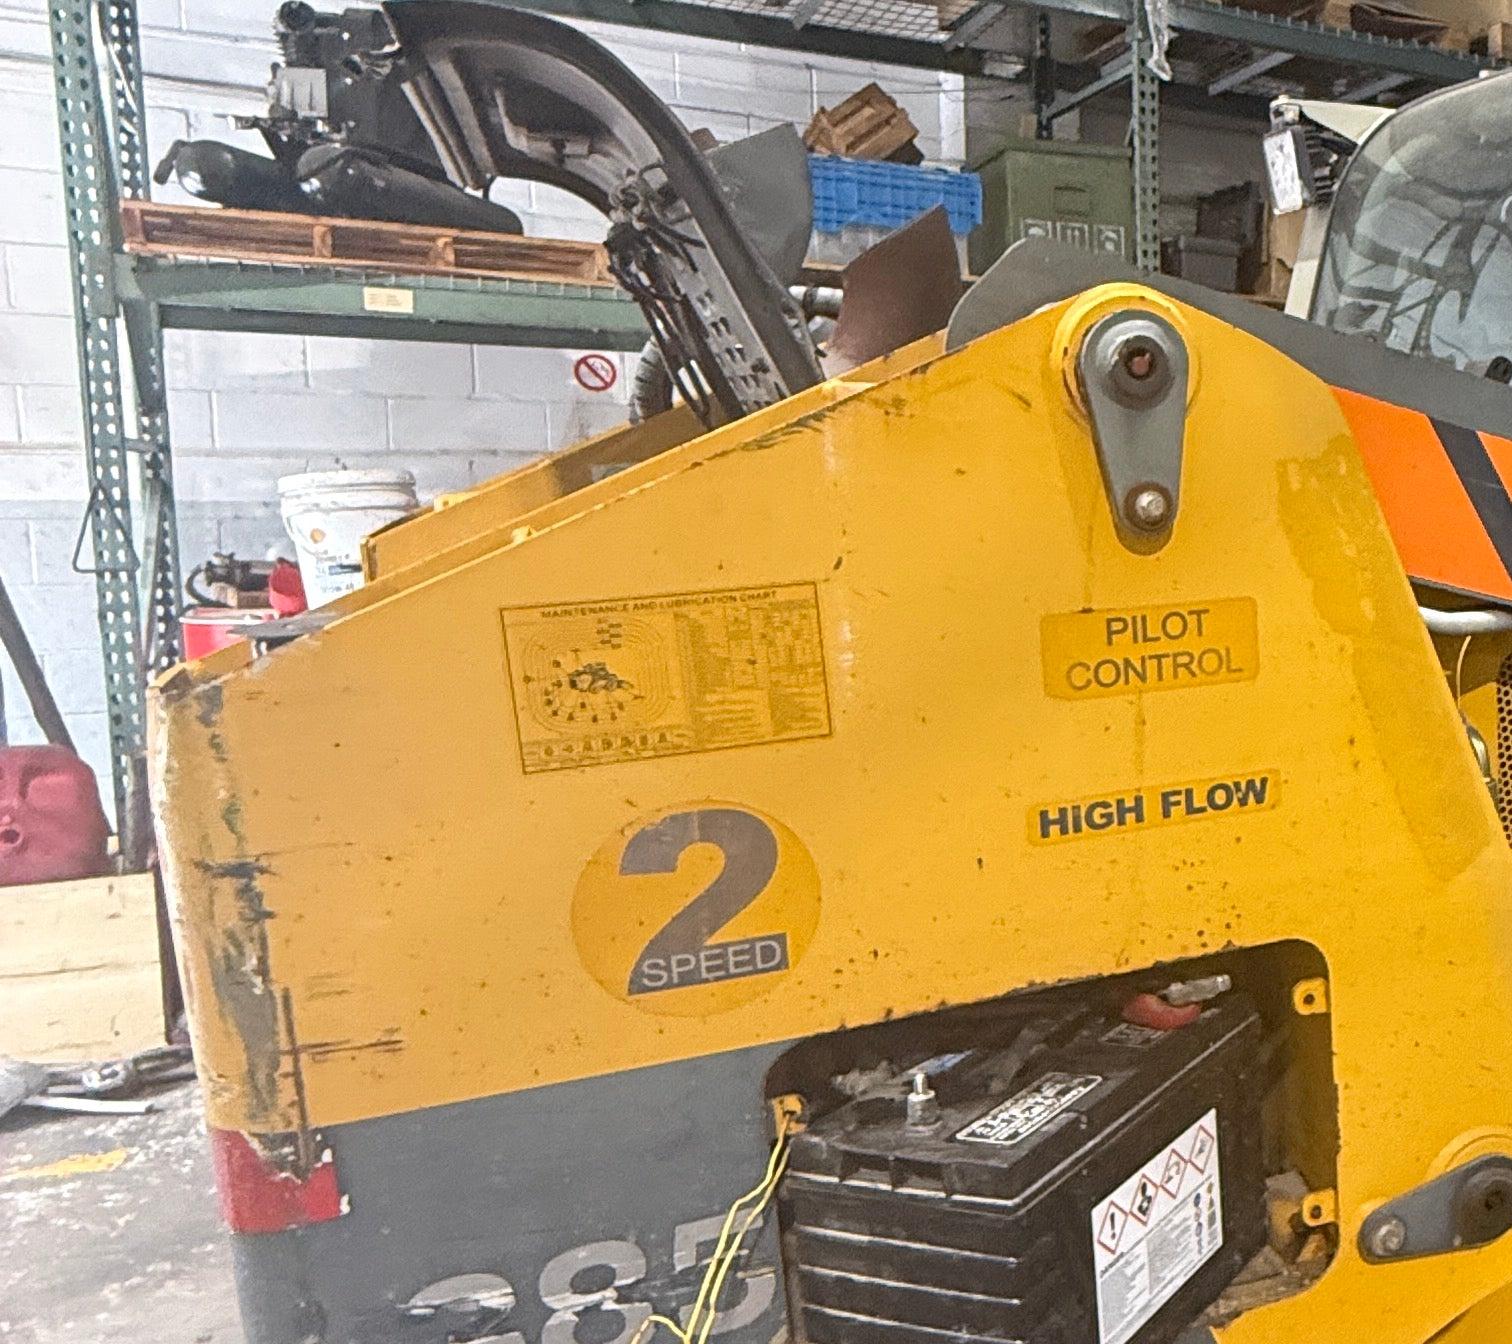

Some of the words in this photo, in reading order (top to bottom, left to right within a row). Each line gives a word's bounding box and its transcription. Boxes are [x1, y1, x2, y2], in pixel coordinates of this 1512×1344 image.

[541, 602, 630, 619] MAINTENANCE
[632, 600, 658, 612] AND
[1105, 608, 1210, 647] PILOT
[1065, 646, 1244, 691] CONTROL
[1038, 793, 1145, 839] HIGH
[1160, 776, 1269, 819] FLOW
[618, 808, 790, 996] 2
[641, 940, 781, 987] SPEED
